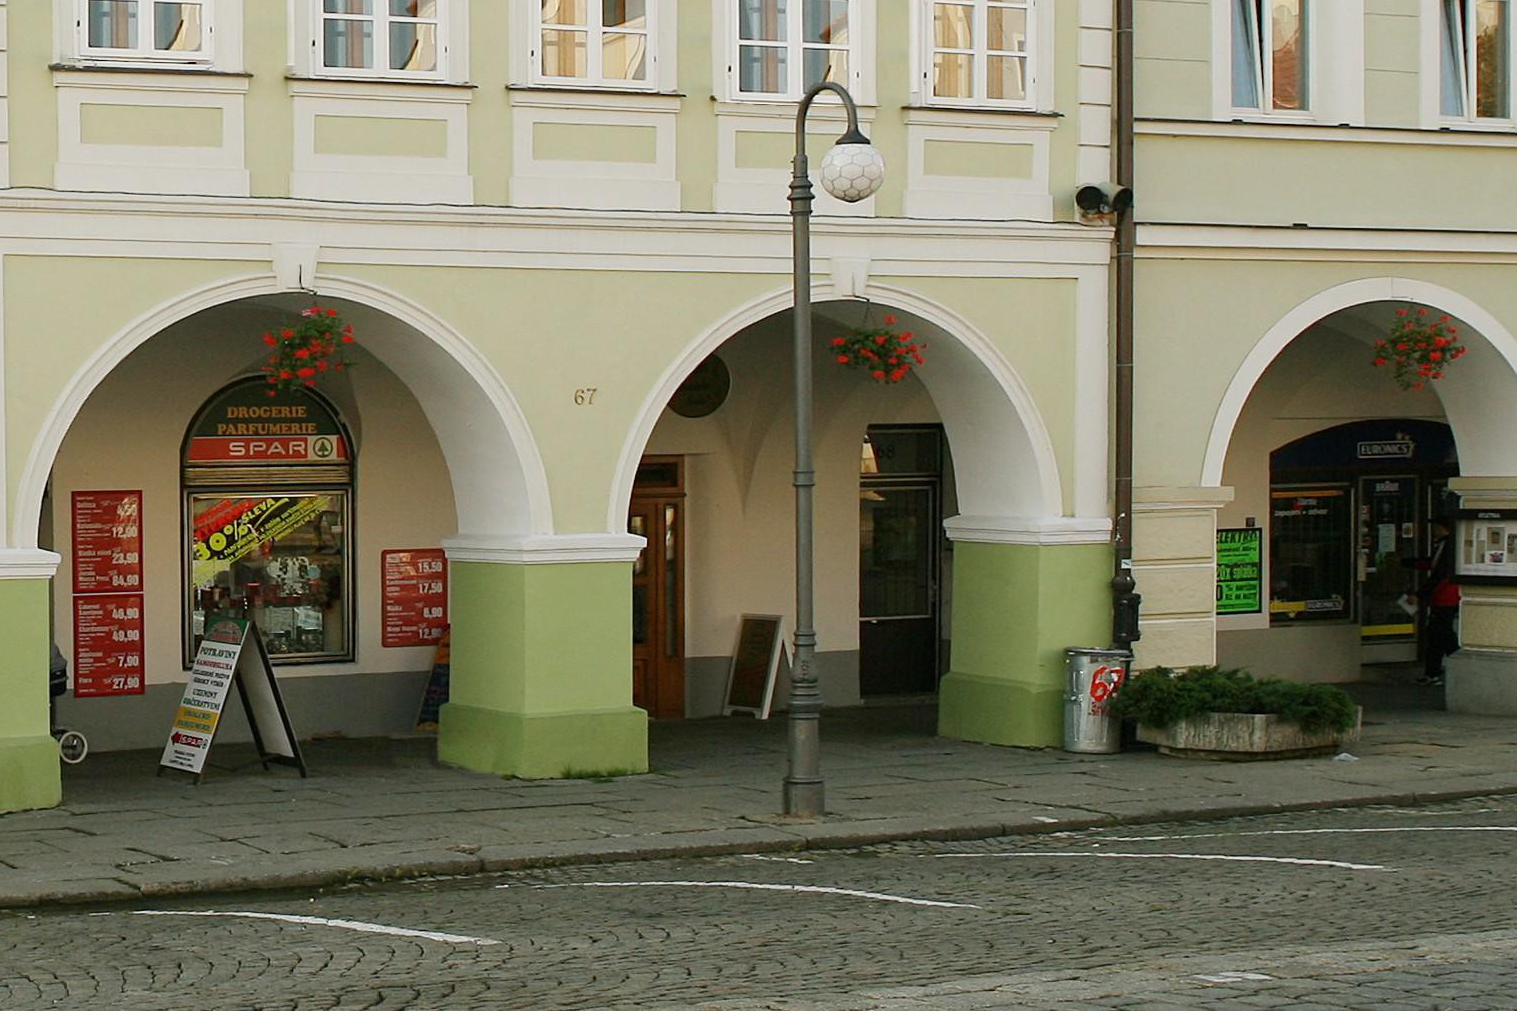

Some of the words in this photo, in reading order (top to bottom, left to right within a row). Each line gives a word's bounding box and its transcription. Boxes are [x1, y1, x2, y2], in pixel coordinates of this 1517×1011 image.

[574, 389, 597, 406] 67
[227, 406, 307, 418] DROGERIE
[217, 423, 317, 435] PARFUMERIE
[229, 442, 306, 456] SPAR
[1361, 443, 1408, 455] EURONICS
[241, 498, 277, 525] SLEVA
